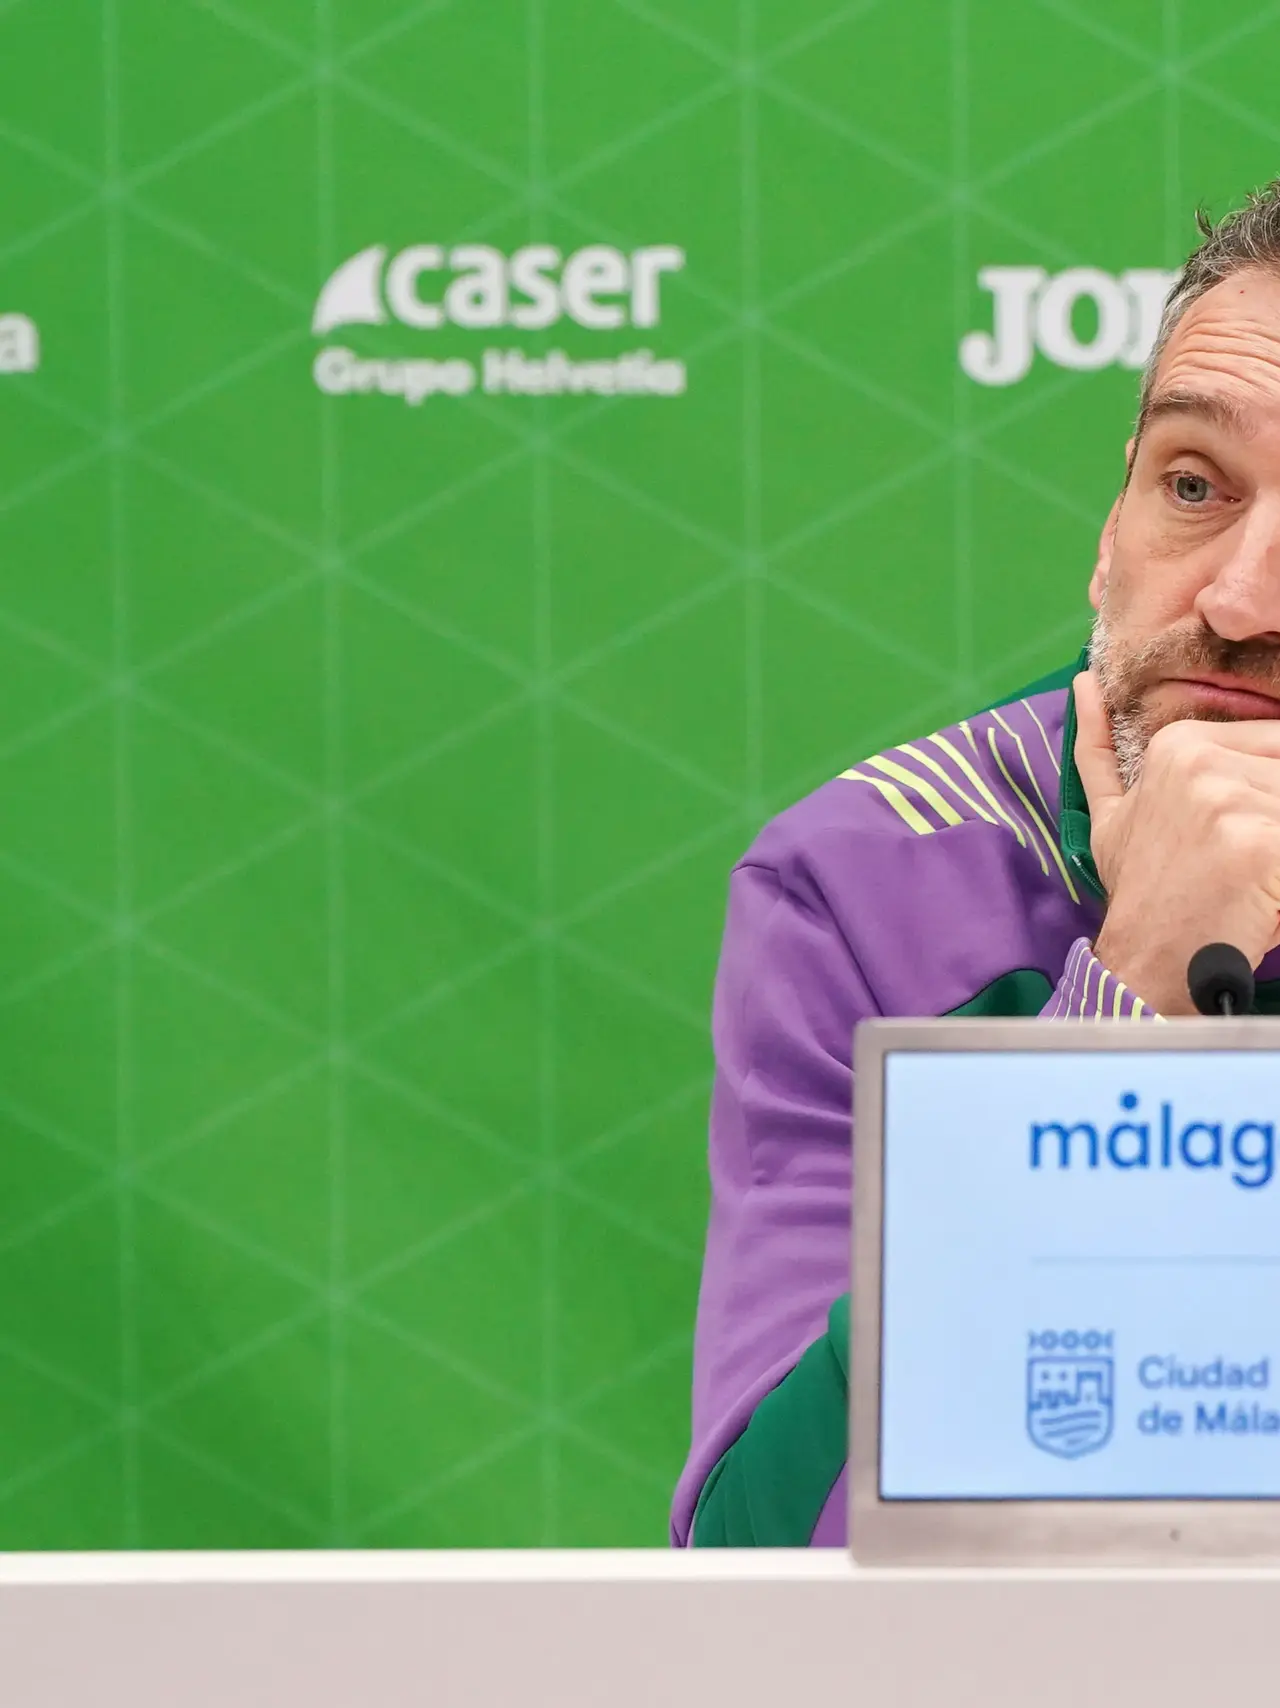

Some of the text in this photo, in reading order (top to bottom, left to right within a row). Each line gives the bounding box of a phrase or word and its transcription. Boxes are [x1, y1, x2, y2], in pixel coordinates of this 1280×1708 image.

[386, 244, 684, 329] caser
[314, 347, 475, 403] Grupo
[1137, 1355, 1270, 1390] Ciudad
[1137, 1403, 1184, 1436] de
